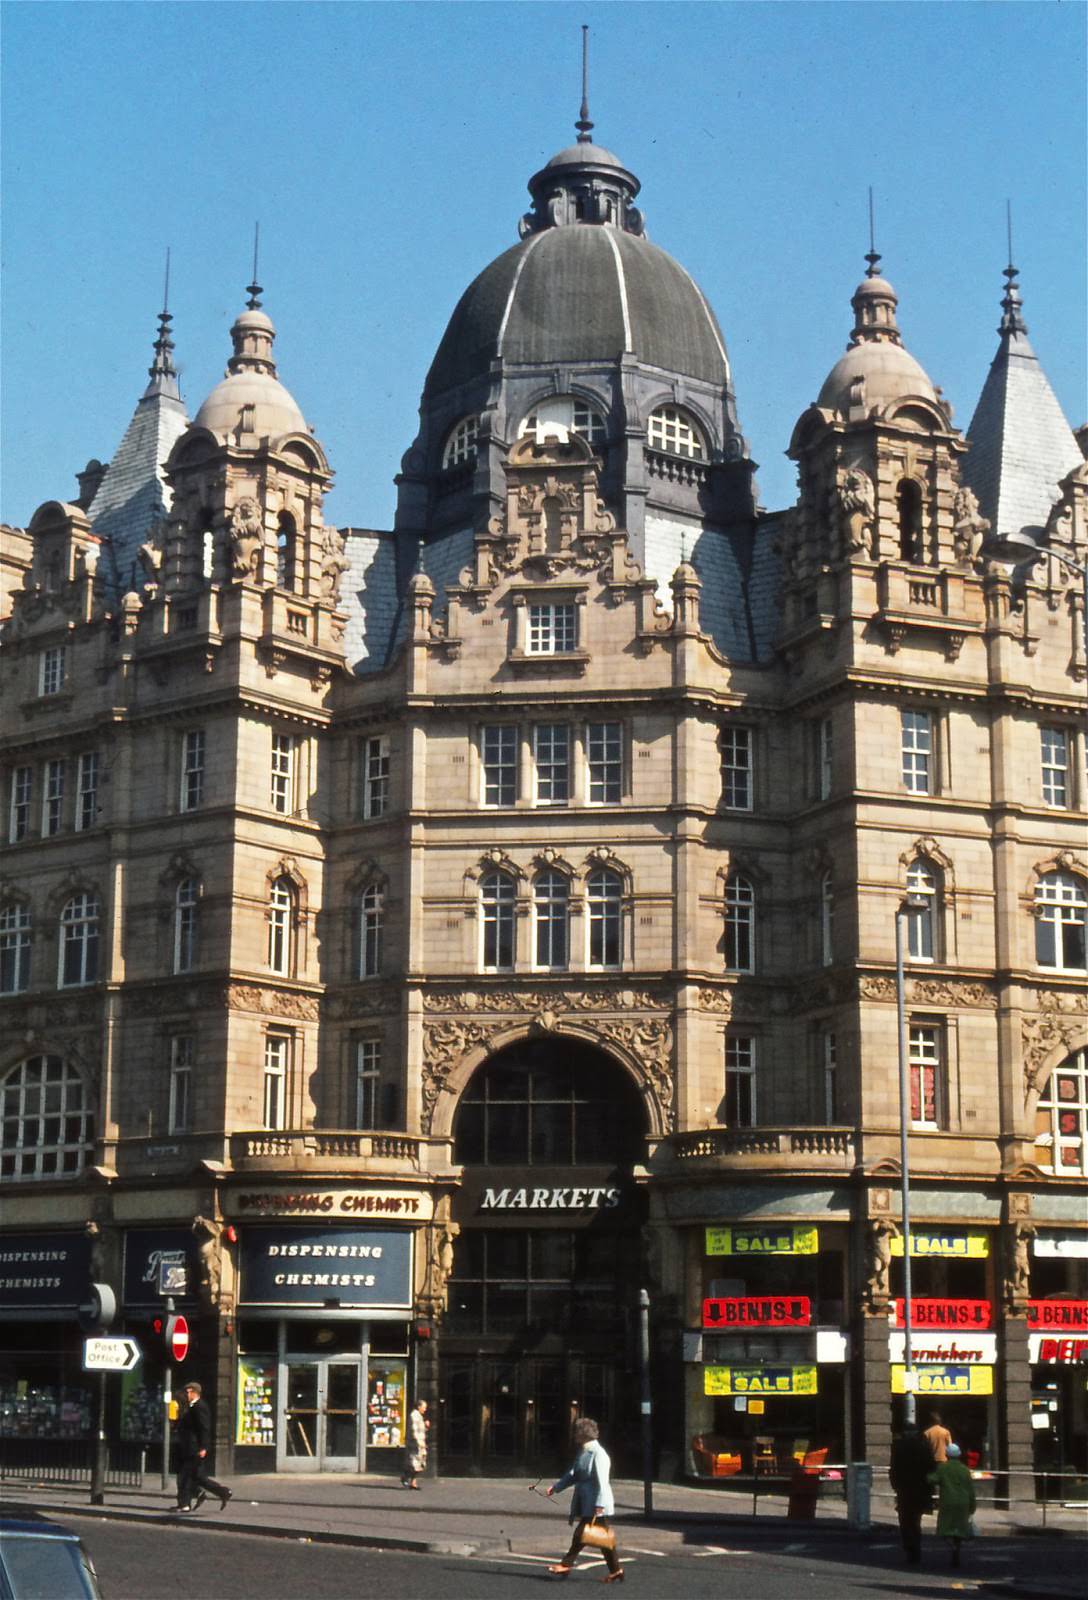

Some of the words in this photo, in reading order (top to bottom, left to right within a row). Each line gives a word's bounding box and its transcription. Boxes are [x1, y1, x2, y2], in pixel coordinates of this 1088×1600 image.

[239, 1194, 334, 1213] DISPENSING
[340, 1196, 420, 1213] CHEMISTS
[481, 1188, 621, 1208] MARKETS
[268, 1244, 383, 1259] DISPENSING
[736, 1237, 790, 1251] SALE
[916, 1238, 966, 1253] SALE
[274, 1273, 376, 1287] CHEMISTS
[725, 1301, 786, 1321] BENNS
[916, 1304, 969, 1324] BENNS
[94, 1342, 117, 1352] Post
[902, 1342, 984, 1361] urnishers
[89, 1354, 121, 1363] Office
[735, 1376, 790, 1390] SALE
[918, 1376, 969, 1391] SALE
